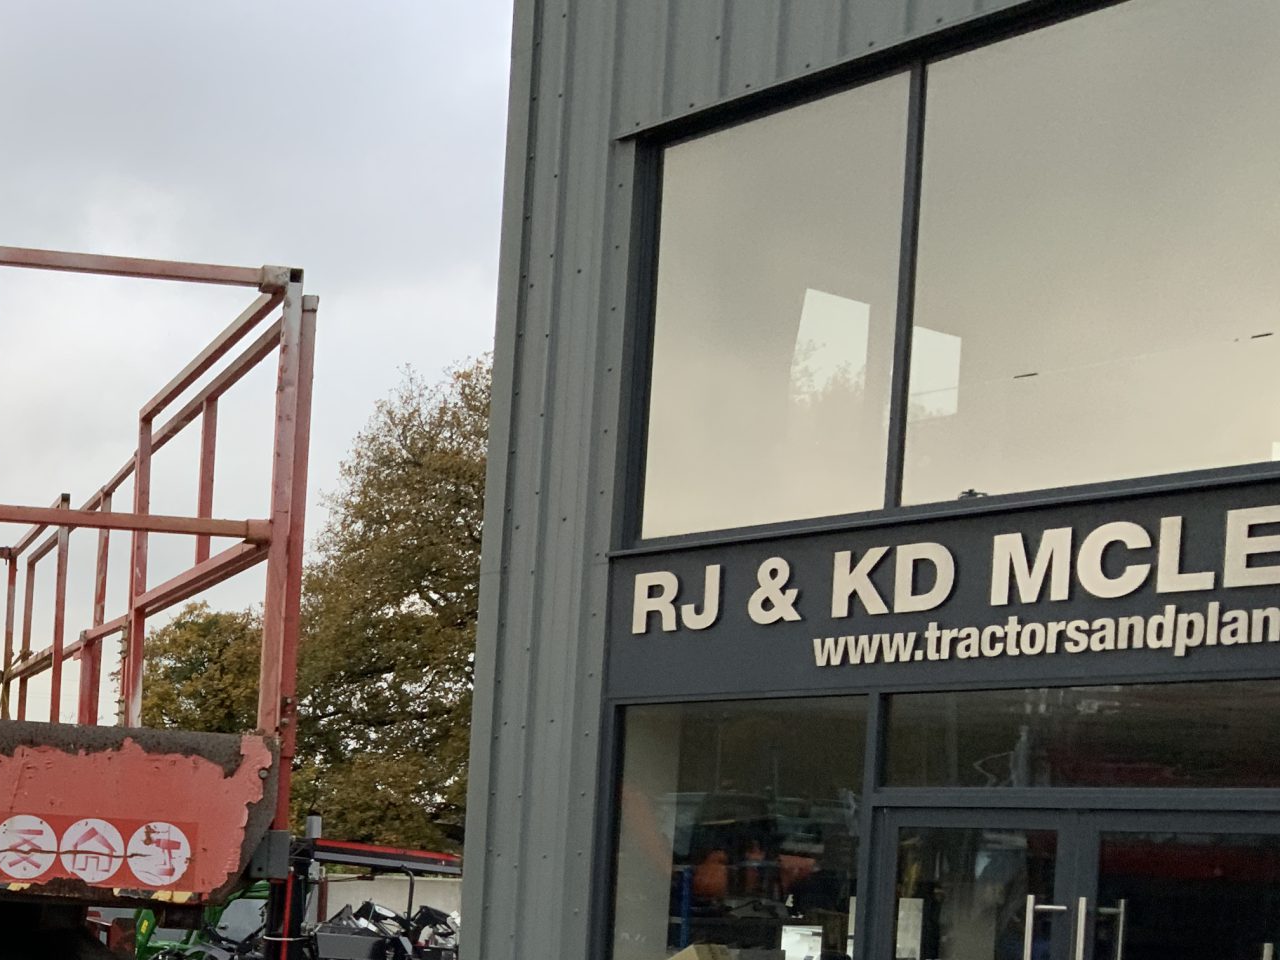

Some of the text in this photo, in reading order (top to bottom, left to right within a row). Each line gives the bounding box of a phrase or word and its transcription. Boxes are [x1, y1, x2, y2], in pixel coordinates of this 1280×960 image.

[632, 505, 1280, 634] RJ & KD MCLE
[813, 601, 1280, 667] www.tractorsandplan
